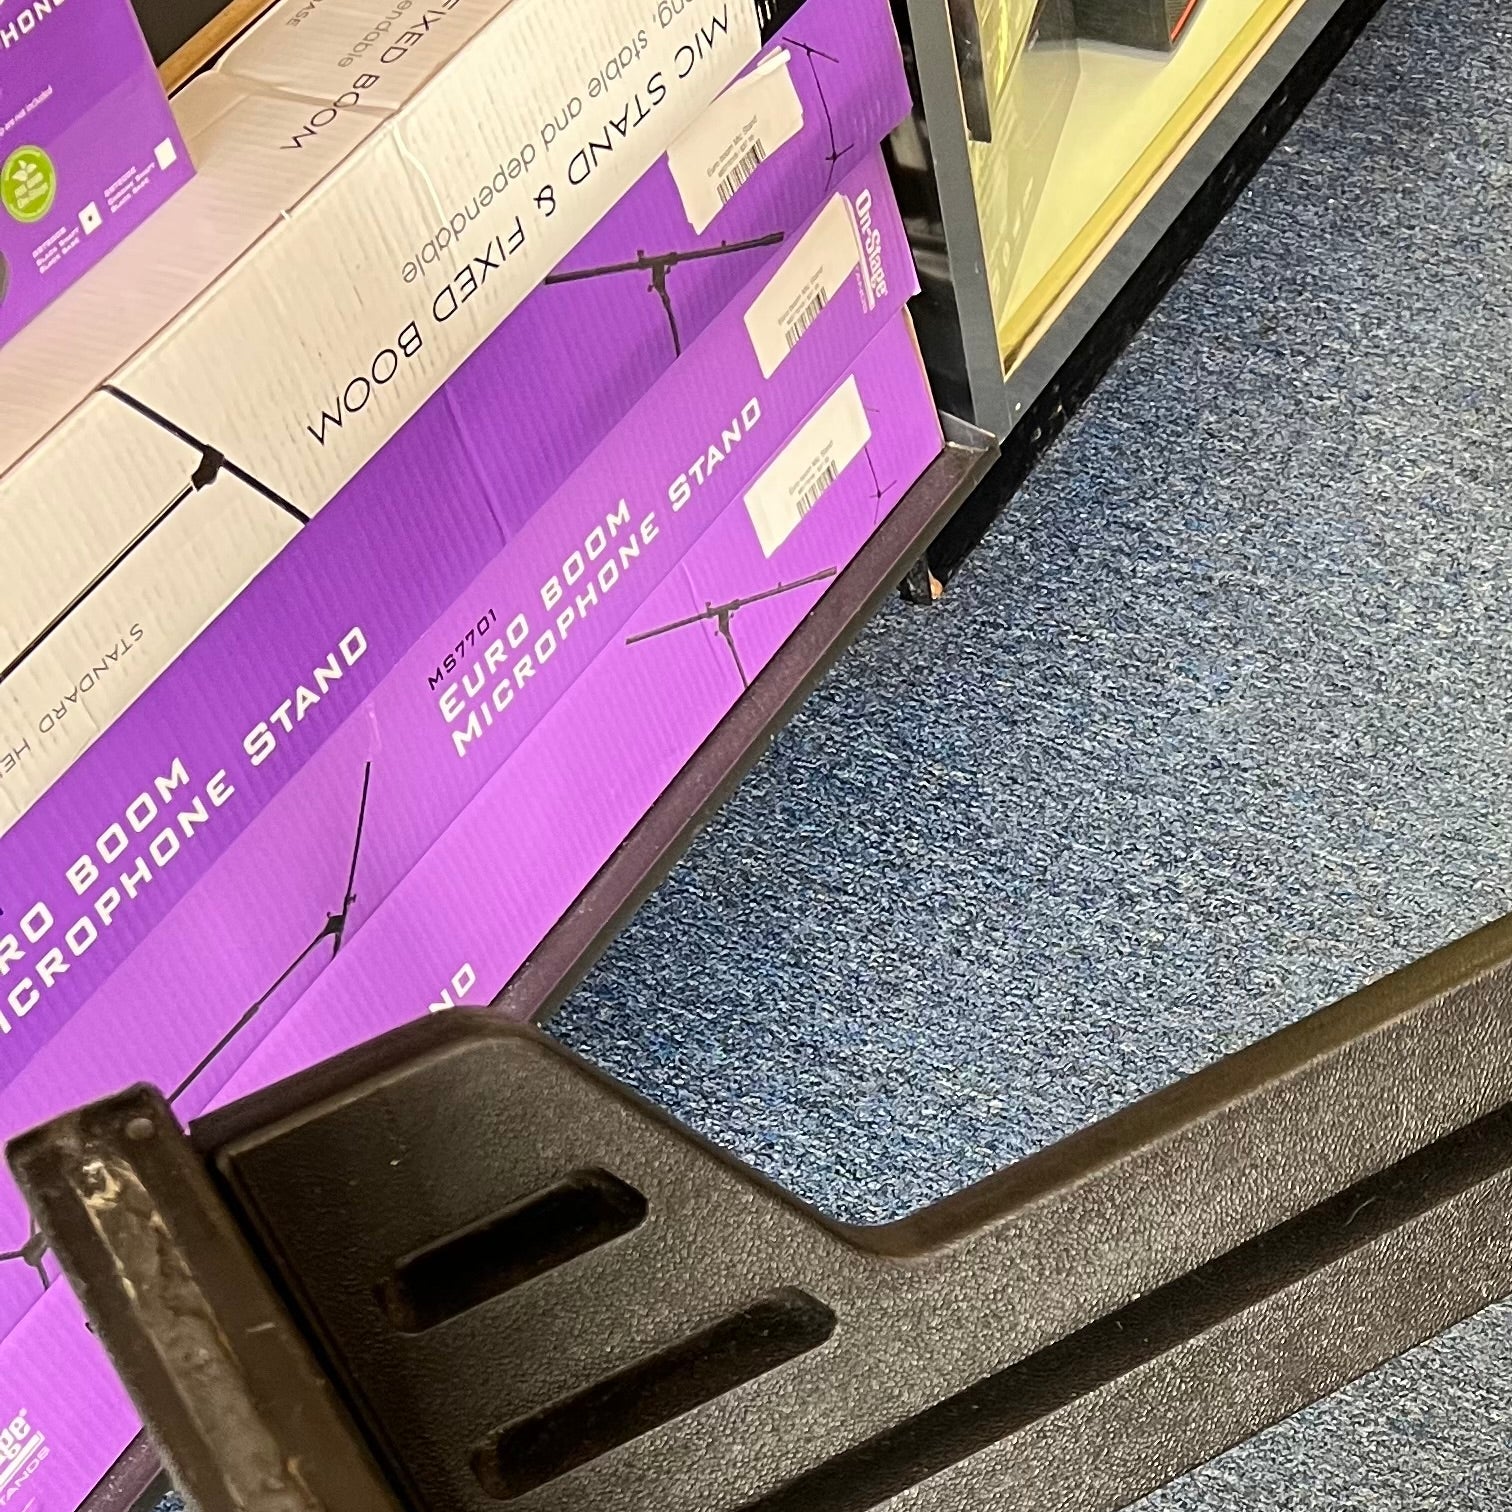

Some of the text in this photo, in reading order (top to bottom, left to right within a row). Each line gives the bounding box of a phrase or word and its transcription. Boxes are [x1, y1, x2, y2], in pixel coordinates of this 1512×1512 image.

[0, 0, 65, 48] HON
[286, 0, 322, 27] ASE
[588, 29, 648, 97] stable
[280, 74, 380, 149] BOOM
[541, 97, 583, 152] and
[307, 3, 728, 445] MIC STAND & FIXED BOOM
[402, 144, 536, 283] dependable
[855, 189, 888, 298] On-Stage
[438, 498, 631, 722] EURO BOOM
[451, 397, 761, 758] MICROPHONE STAND
[0, 623, 144, 779] STANDARD HE
[243, 626, 368, 767] STAND
[428, 608, 498, 690] MS7701
[65, 757, 190, 896] BOOM
